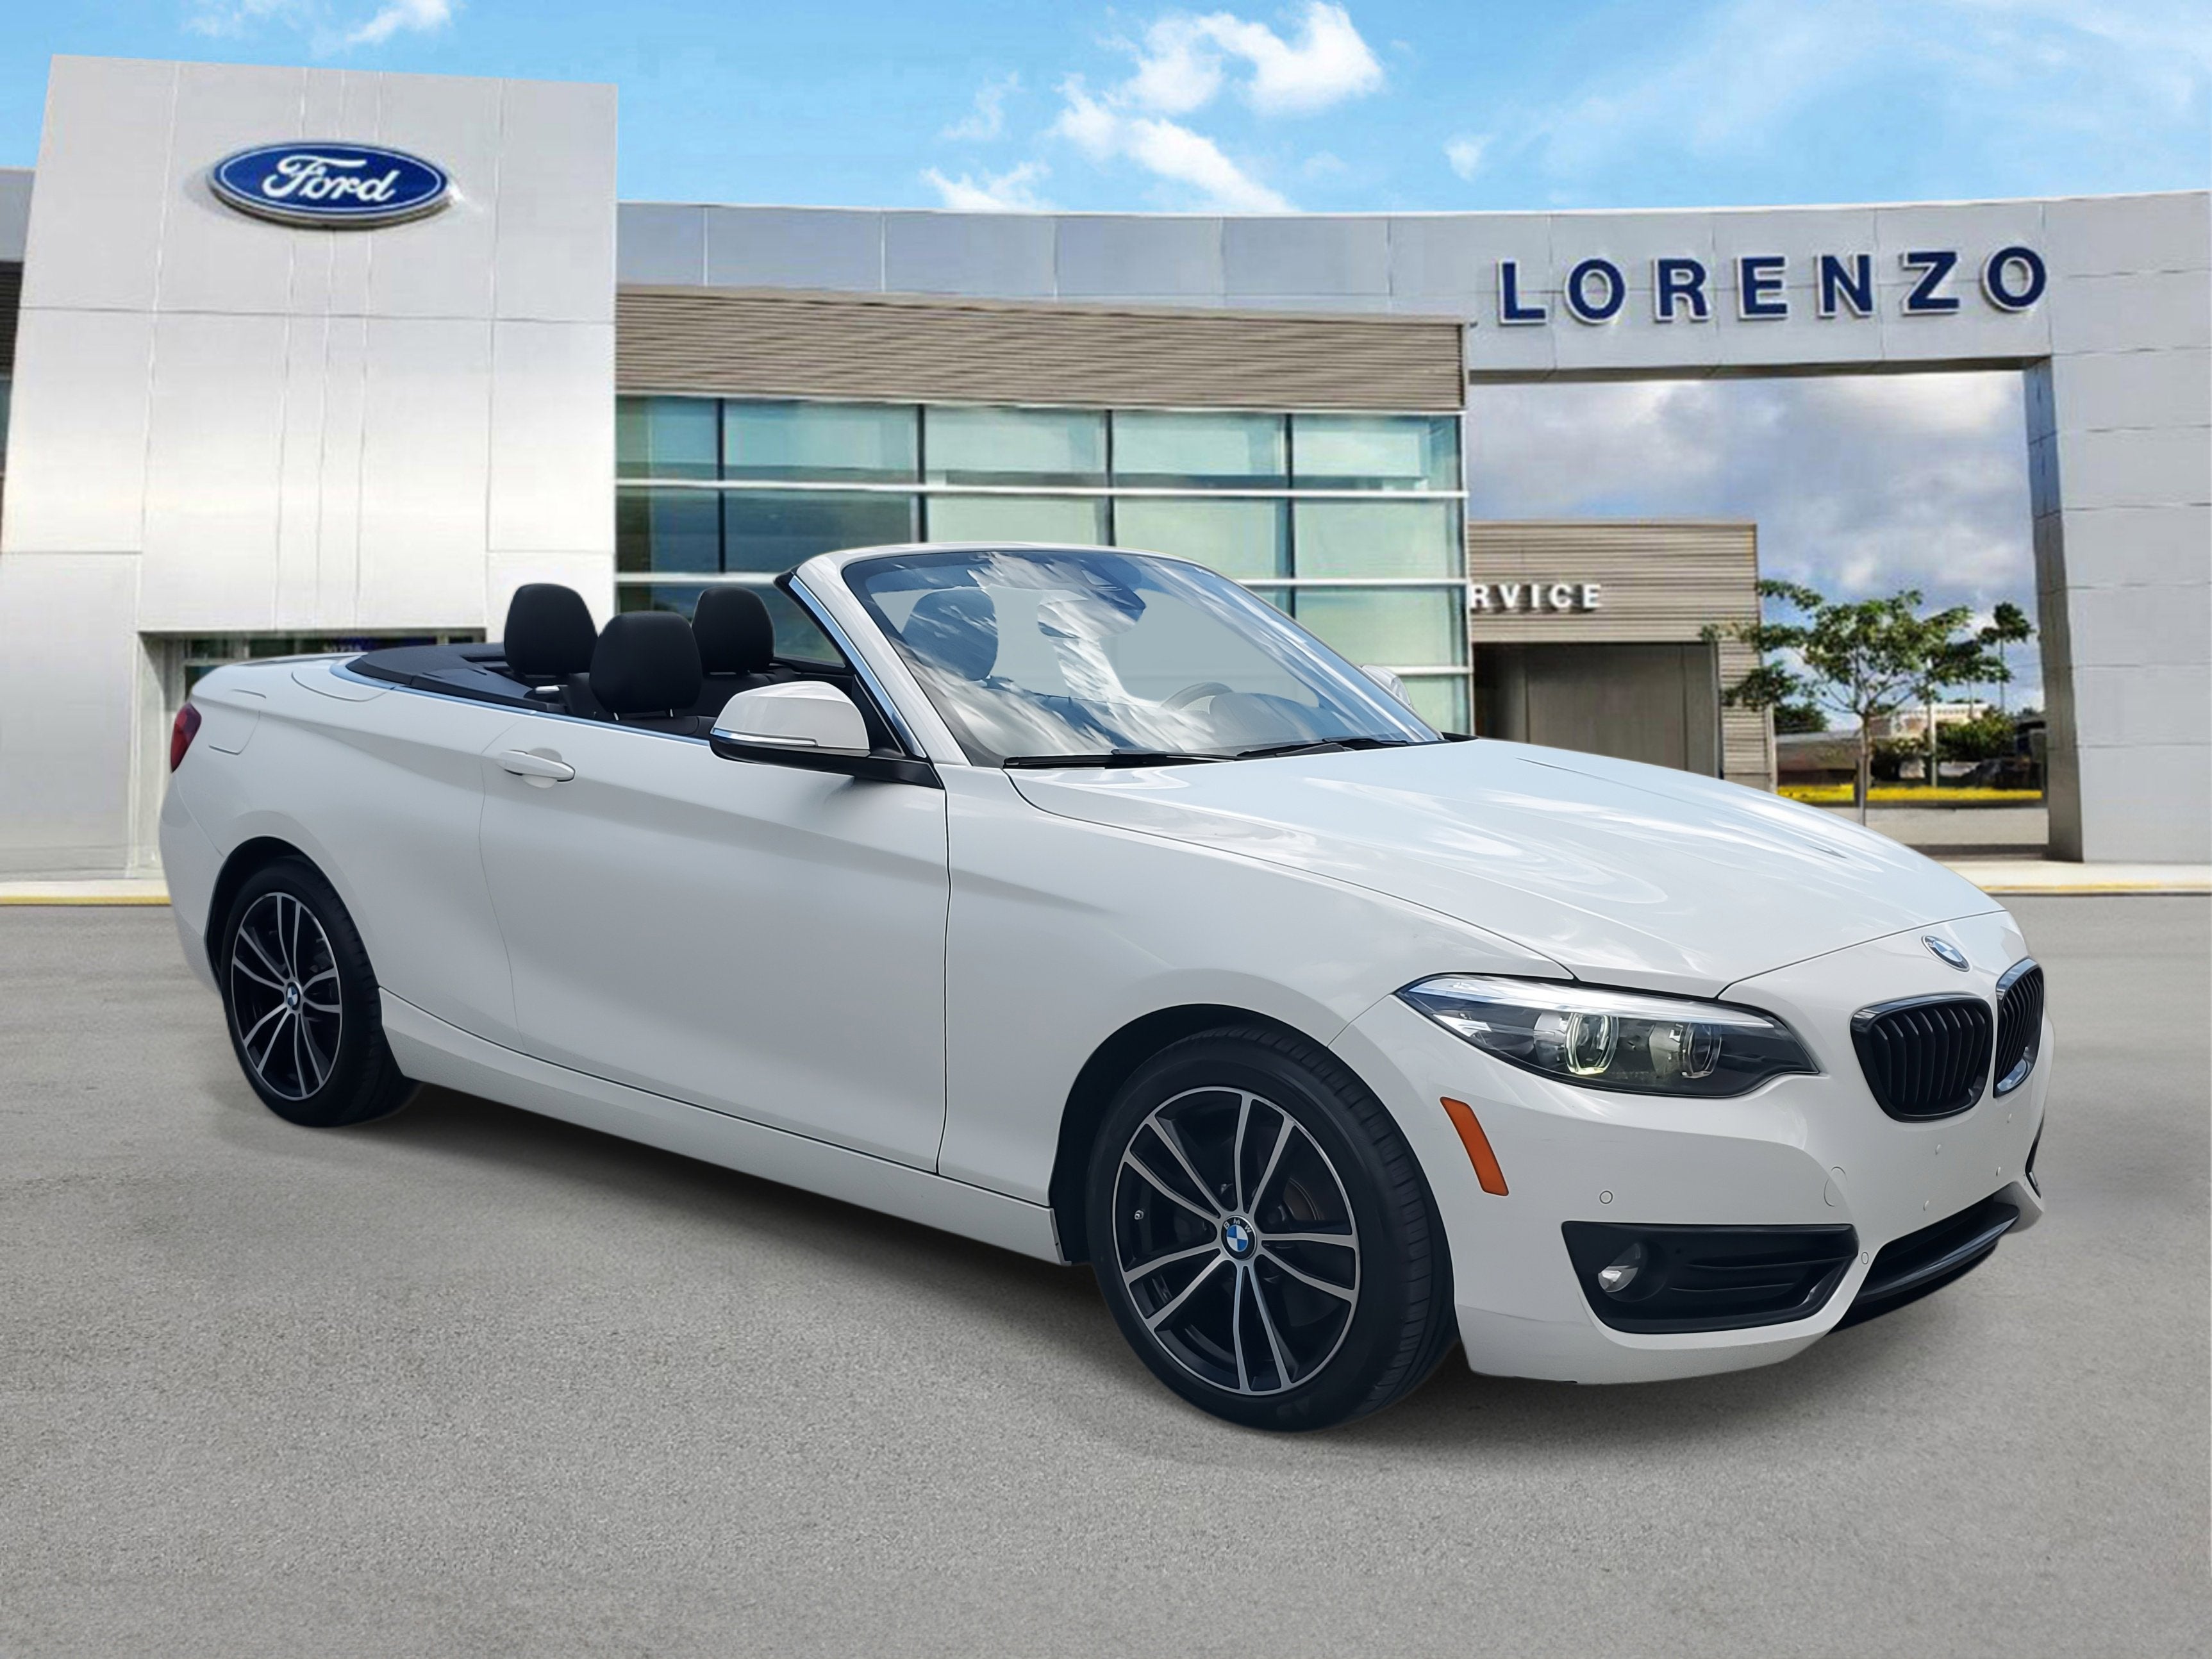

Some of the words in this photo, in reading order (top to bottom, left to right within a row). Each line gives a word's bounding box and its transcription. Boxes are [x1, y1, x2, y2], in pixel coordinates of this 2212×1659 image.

[262, 154, 401, 203] Ford
[1500, 246, 2047, 322] LORENZO
[1224, 1218, 1252, 1233] BMW
